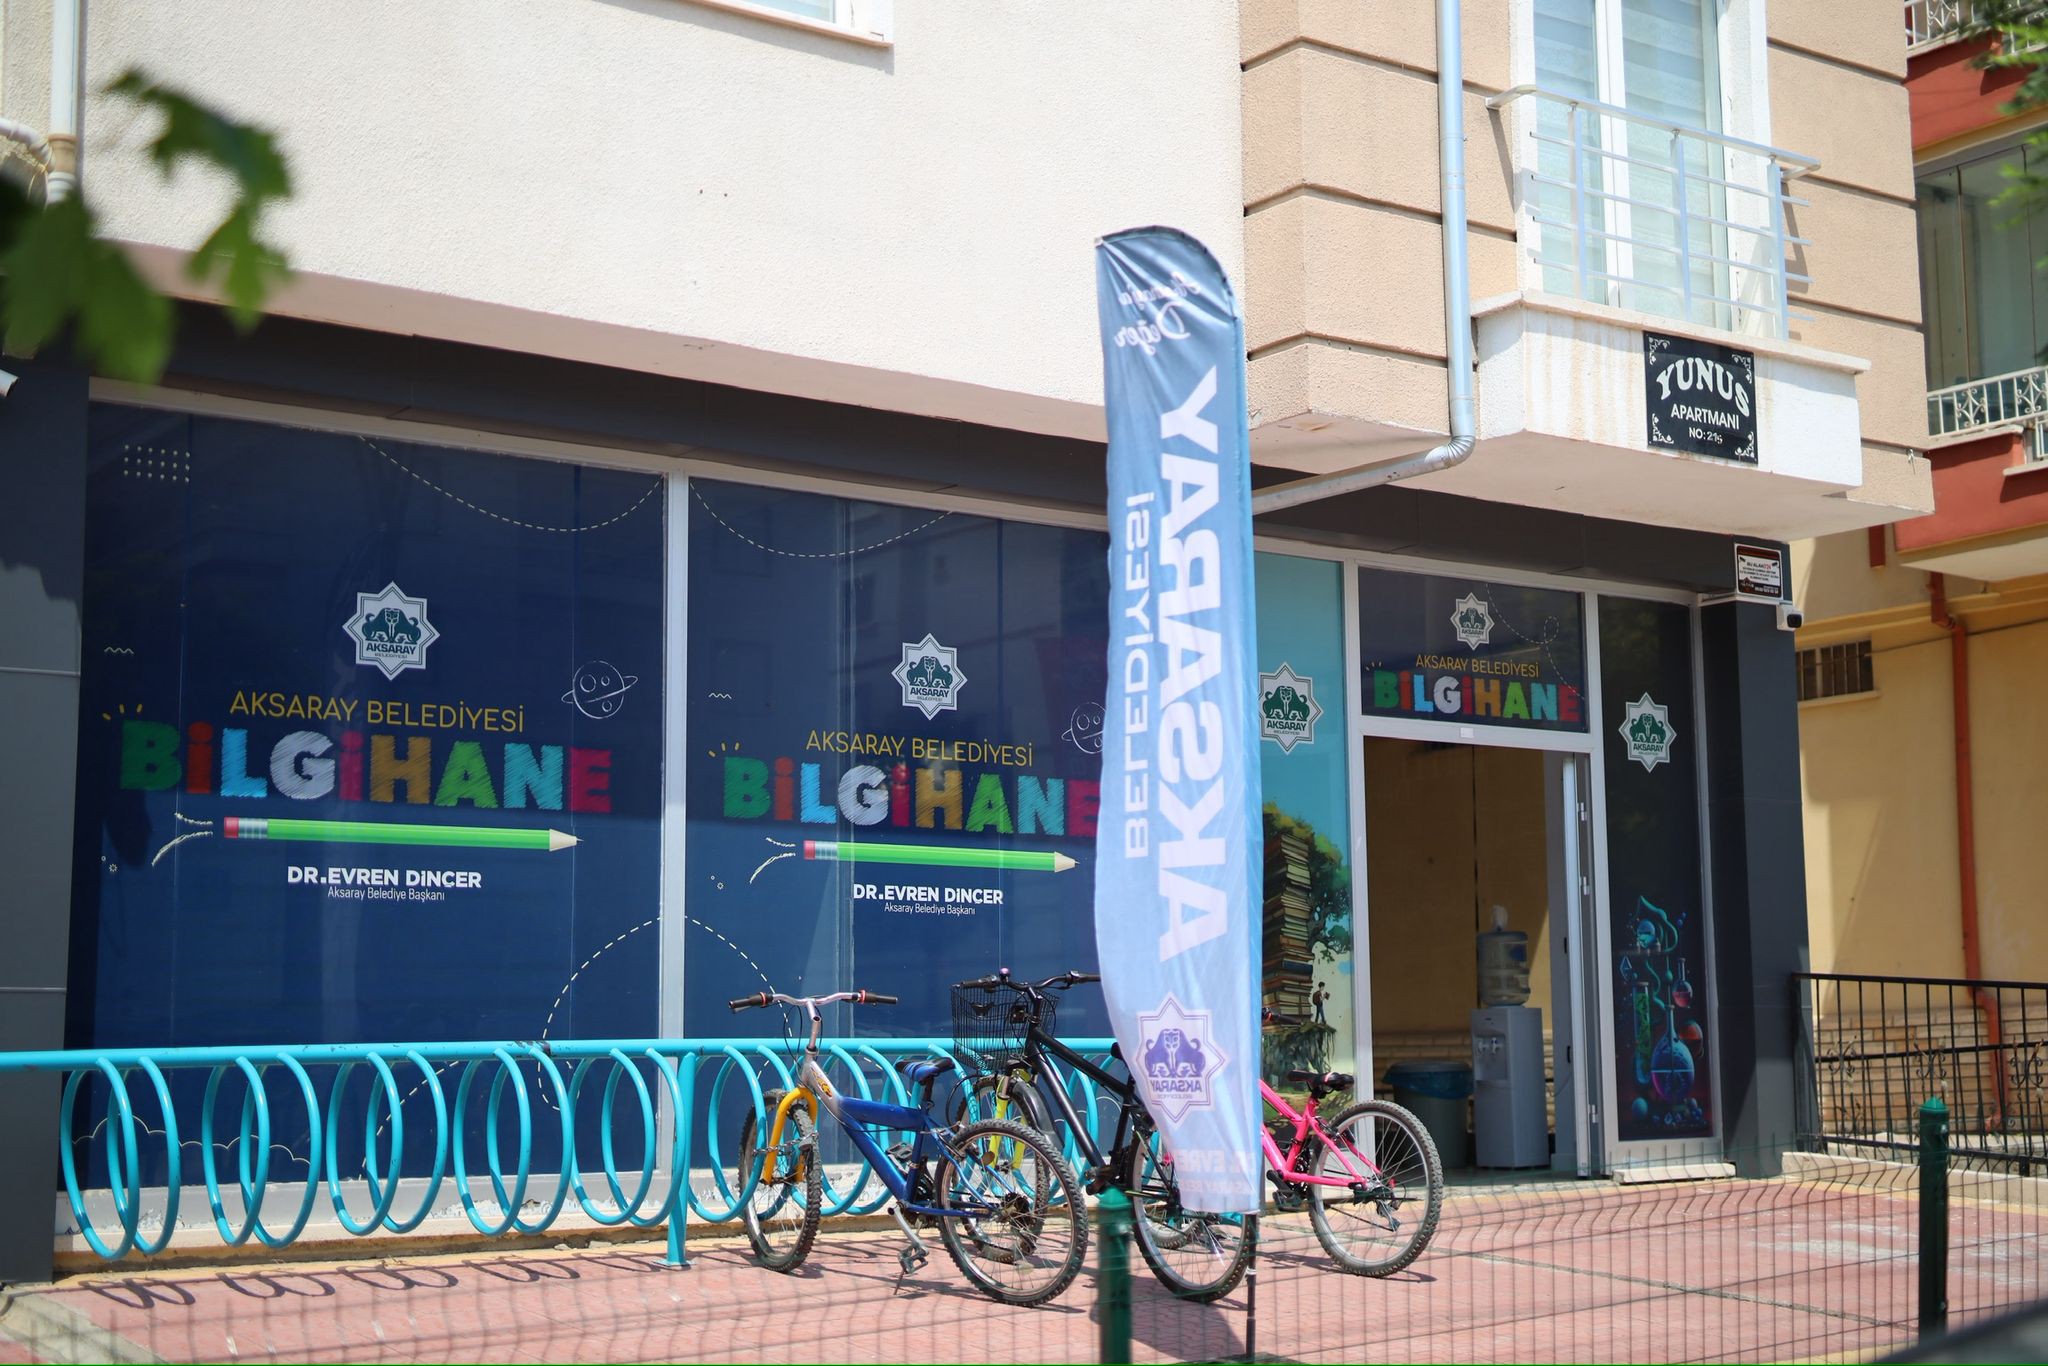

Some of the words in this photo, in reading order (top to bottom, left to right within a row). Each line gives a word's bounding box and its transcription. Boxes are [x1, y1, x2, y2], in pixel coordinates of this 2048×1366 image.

[1656, 357, 1750, 417] YUNUS
[1670, 403, 1740, 430] APARTMANI
[366, 642, 416, 655] AKSARAY
[1415, 654, 1468, 671] AKSARAY
[1471, 659, 1540, 678] BELEDİYESİ
[910, 687, 949, 698] AKSARAY
[1374, 670, 1580, 722] BİLGİHANE
[229, 690, 358, 721] AKSARAY
[367, 700, 524, 733] BELEDİYESİ
[1266, 720, 1307, 732] AKSARAY
[806, 730, 905, 757] AKSARAY
[912, 738, 1032, 767] BELEDİYESİ
[1633, 743, 1664, 752] AKSARAY
[119, 718, 613, 813] BİLGİHANE
[723, 756, 1100, 837] BİLGİHANE
[327, 886, 366, 899] Aksaray
[367, 887, 406, 902] Belediye
[408, 888, 445, 903] Başkanı
[884, 902, 914, 915] Aksaray
[915, 902, 945, 916] Belediye
[947, 904, 976, 917] Başkanı
